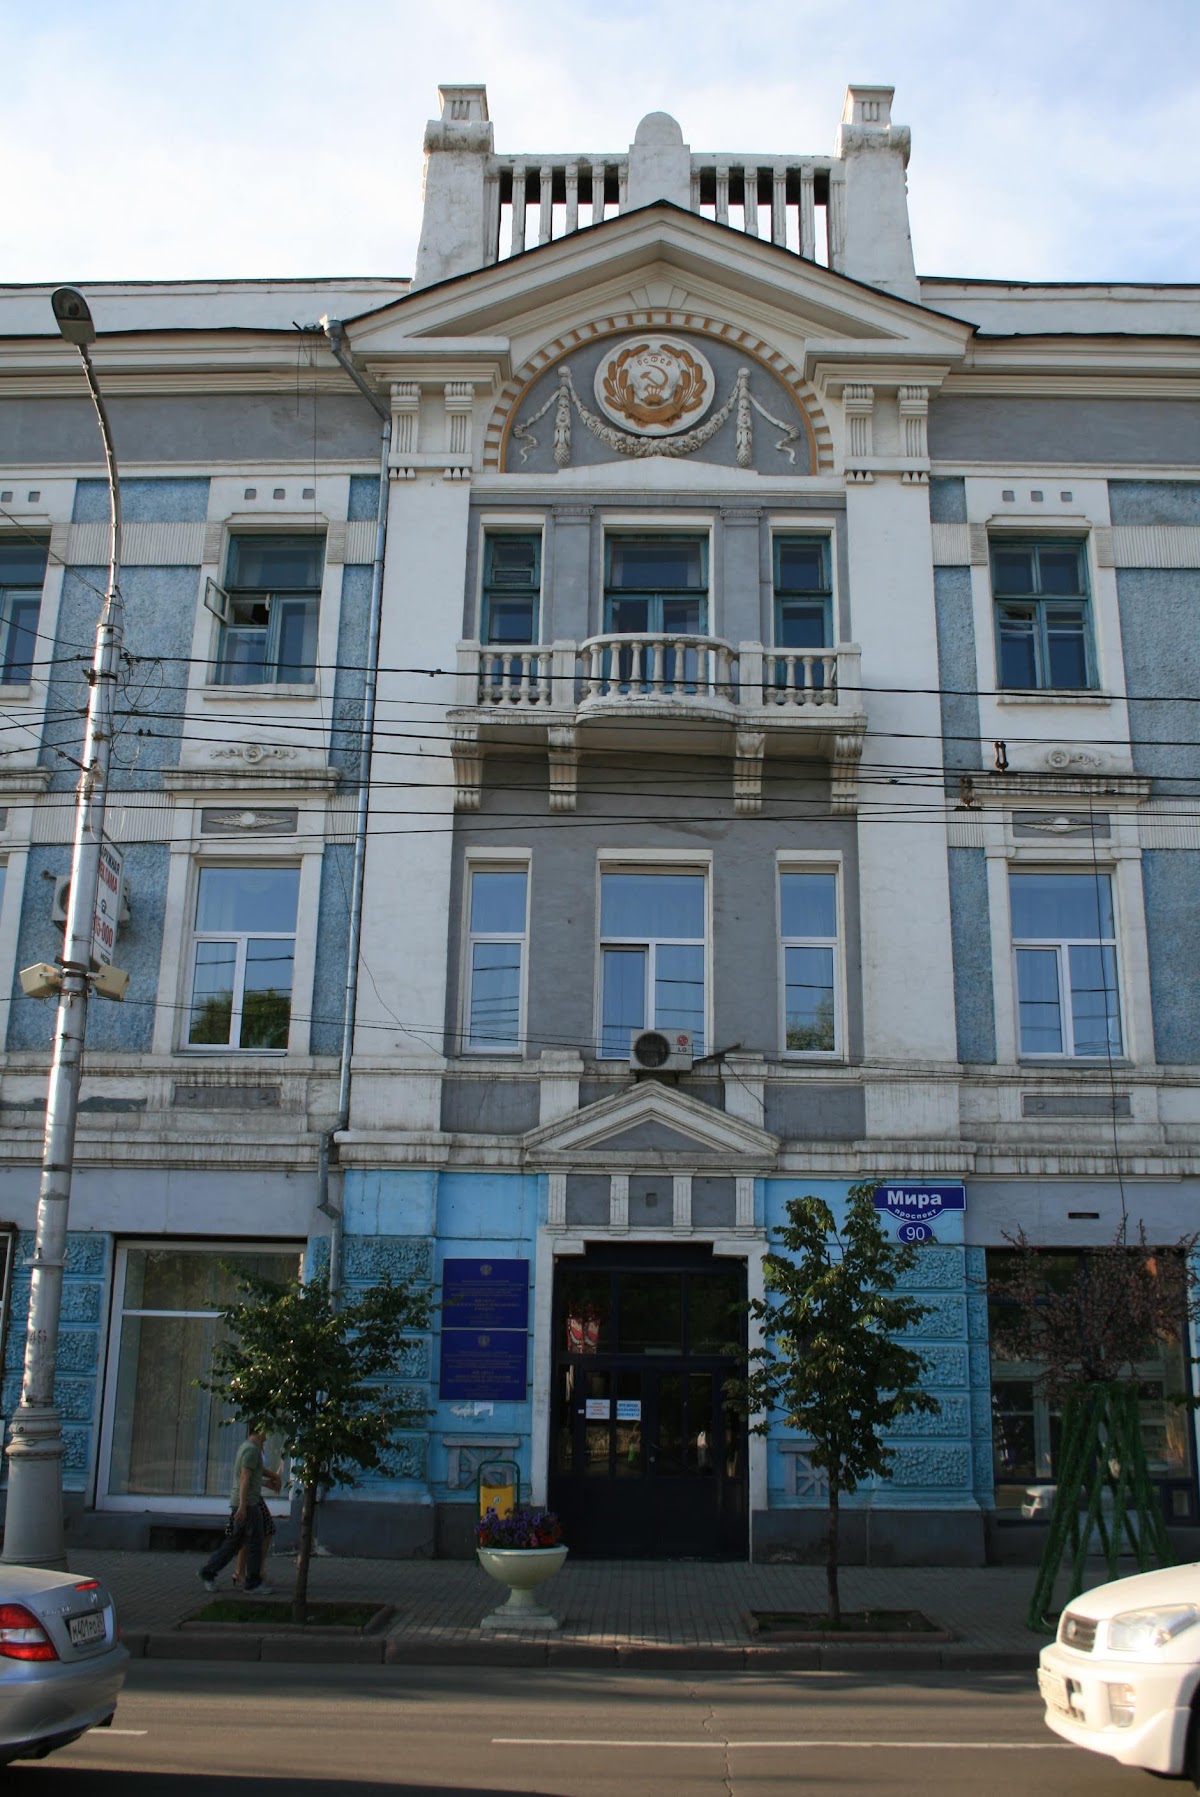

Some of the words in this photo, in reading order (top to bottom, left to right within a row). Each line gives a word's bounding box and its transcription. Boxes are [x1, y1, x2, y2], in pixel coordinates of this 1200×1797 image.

[637, 356, 672, 367] РСФСР
[887, 1190, 942, 1209] Мира
[894, 1208, 937, 1219] проспект
[906, 1226, 925, 1241] 90
